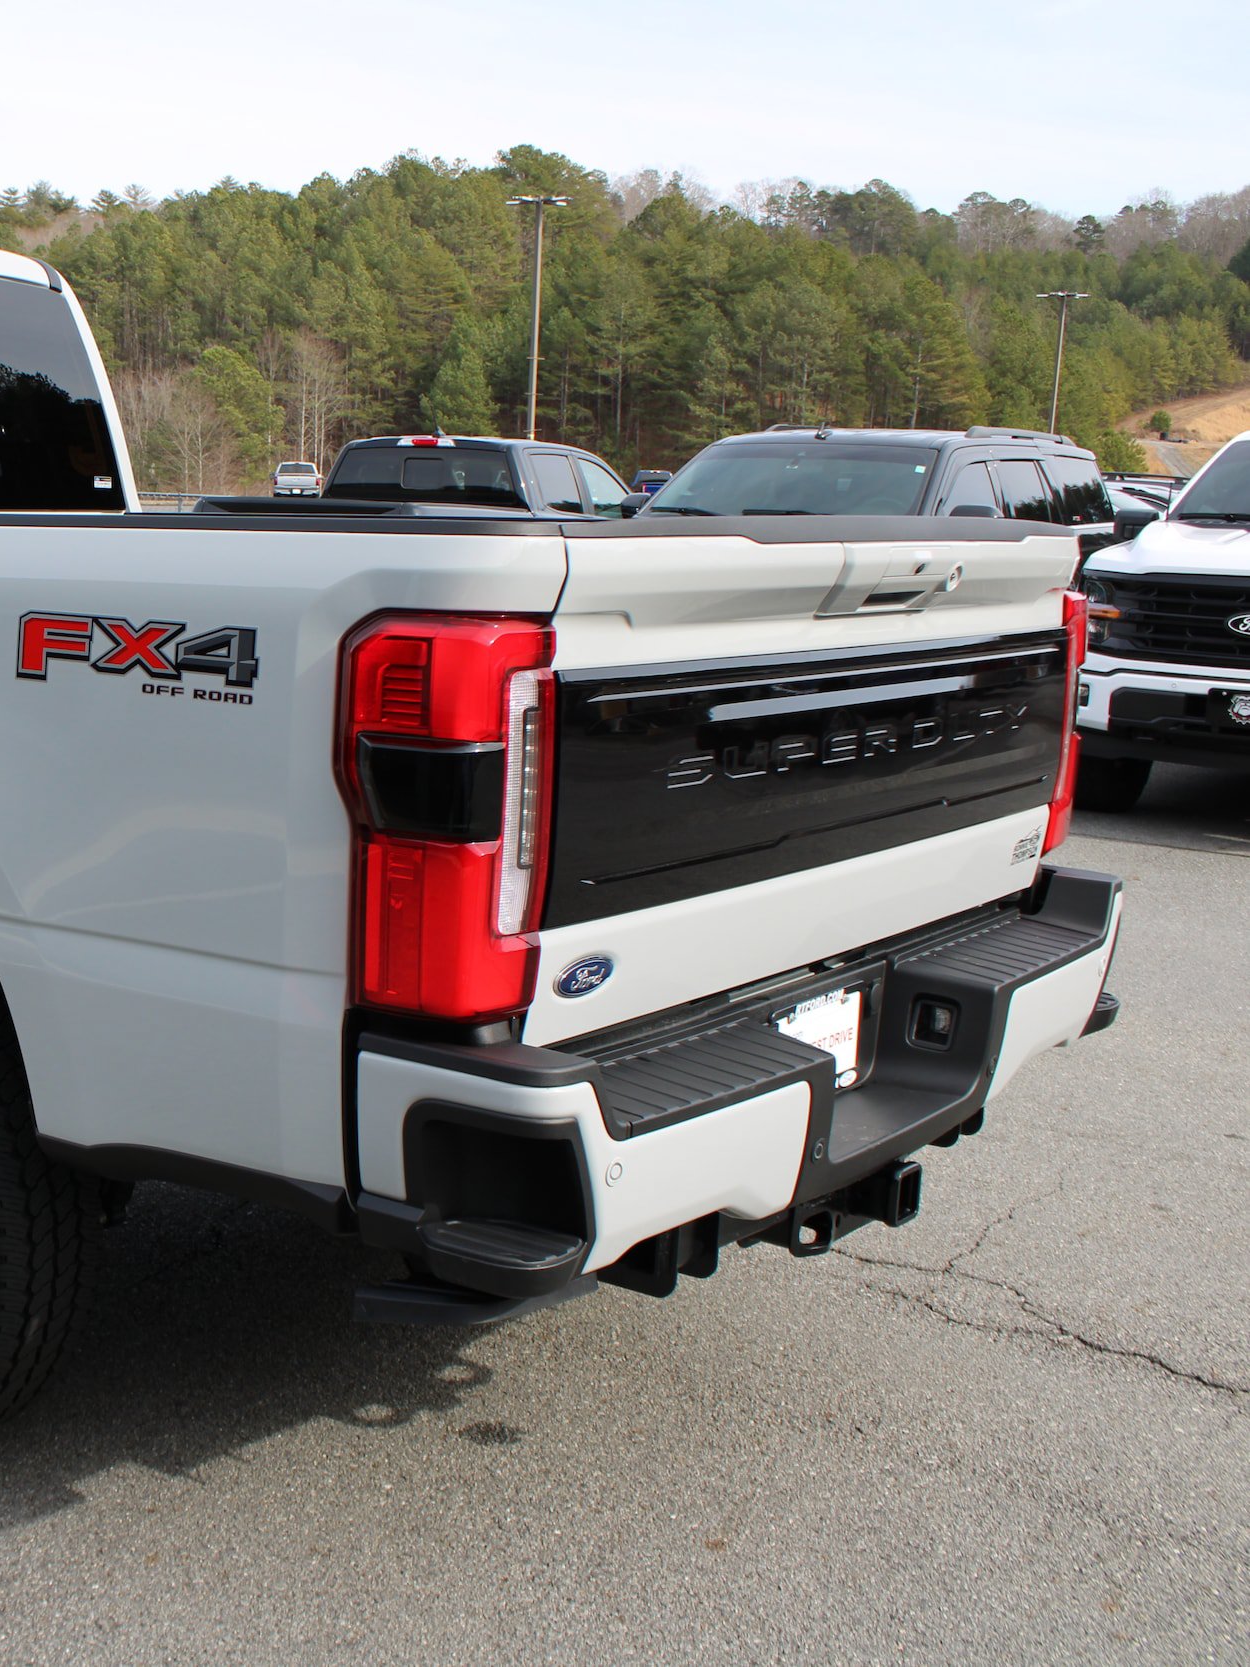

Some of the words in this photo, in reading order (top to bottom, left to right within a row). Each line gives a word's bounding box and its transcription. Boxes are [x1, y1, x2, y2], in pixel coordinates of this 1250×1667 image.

[17, 610, 258, 687] FX4
[141, 683, 184, 697] OFF
[193, 689, 254, 705] ROAD
[666, 723, 898, 789] SUPER
[570, 965, 605, 991] Ford
[830, 1027, 854, 1048] DRIVE
